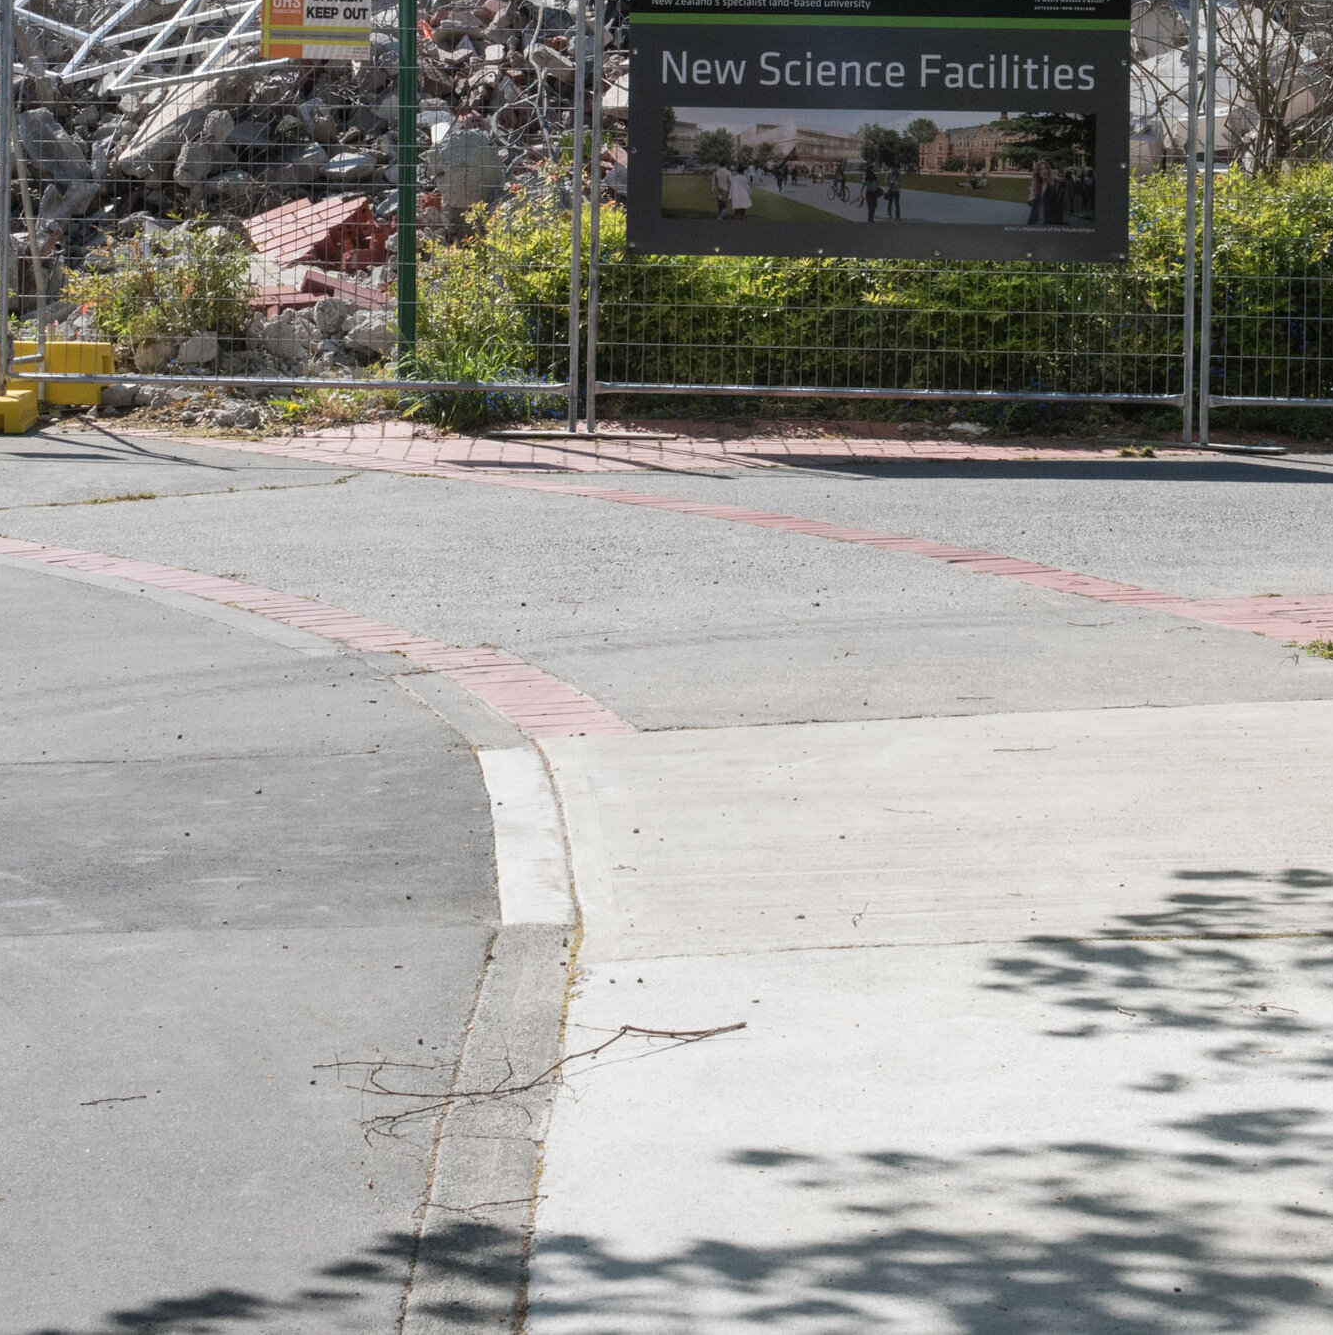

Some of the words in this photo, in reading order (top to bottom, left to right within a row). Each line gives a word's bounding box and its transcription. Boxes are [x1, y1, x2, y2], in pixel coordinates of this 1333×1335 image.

[306, 7, 339, 19] KEEP
[343, 7, 368, 20] OUT
[661, 51, 746, 85] New
[759, 52, 905, 87] Science
[921, 54, 1095, 91] Facilities
